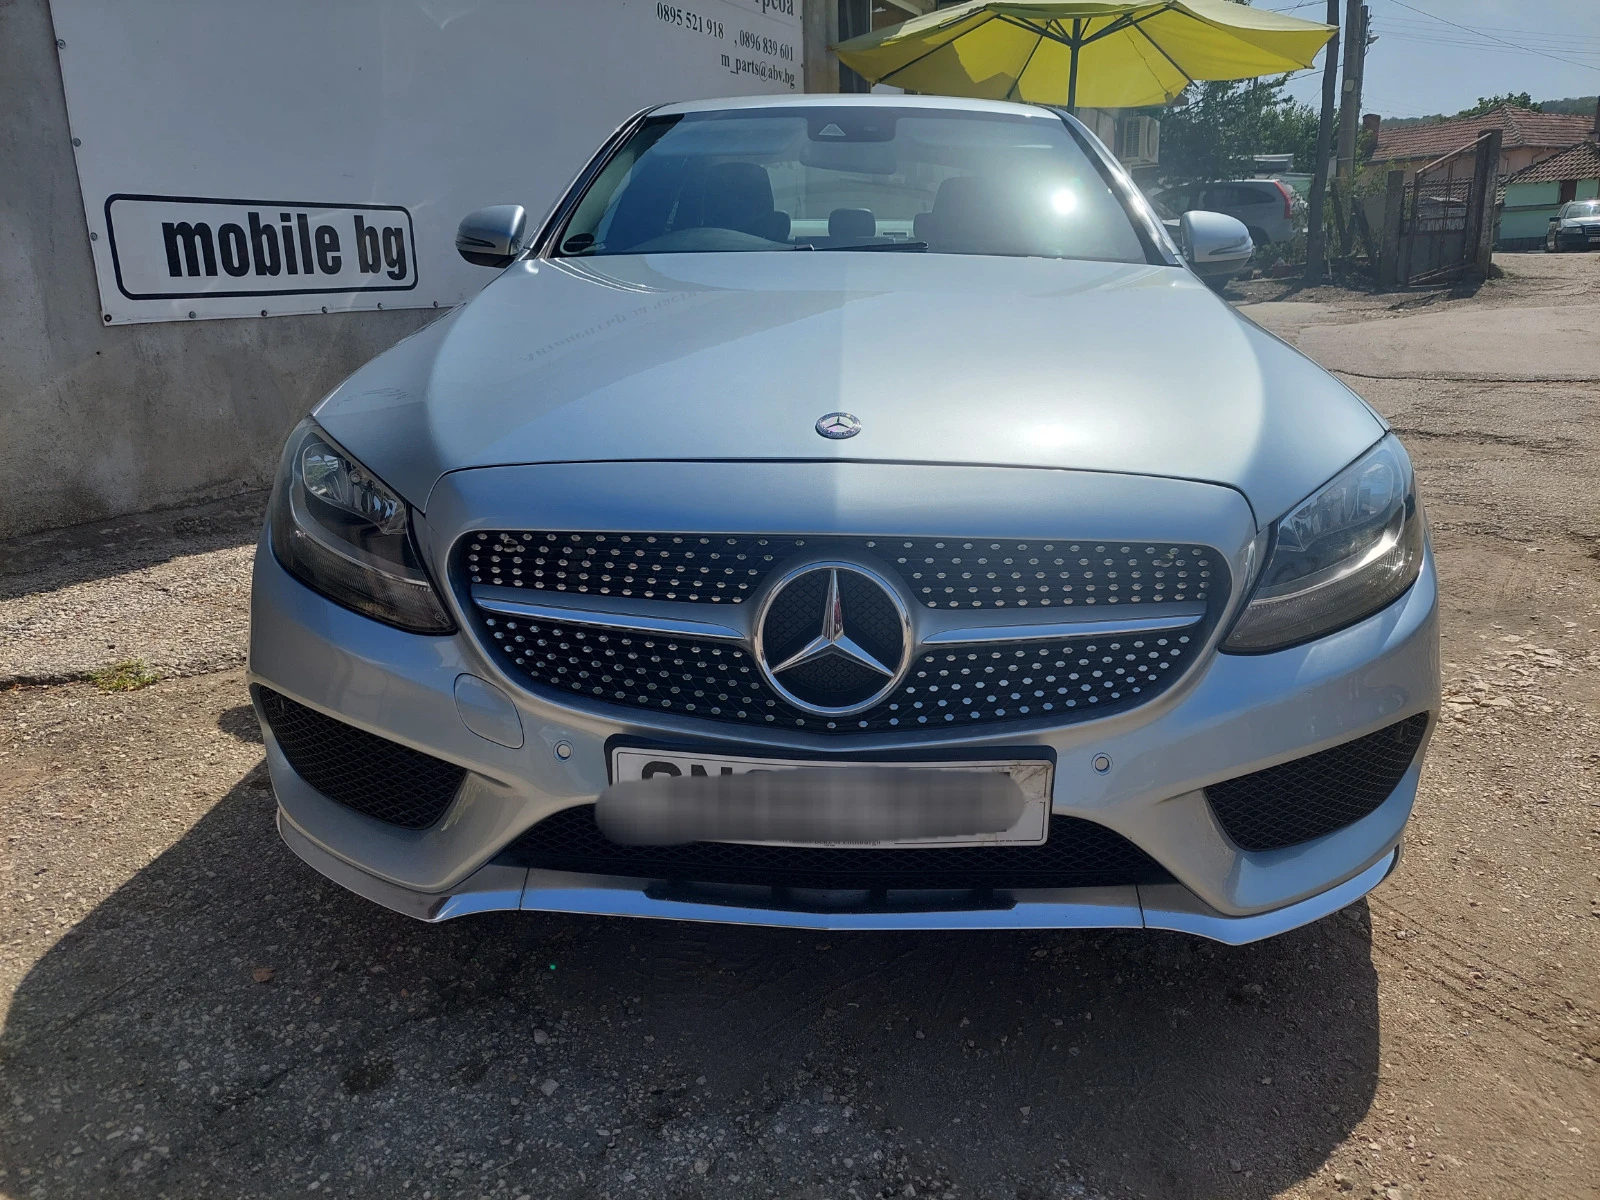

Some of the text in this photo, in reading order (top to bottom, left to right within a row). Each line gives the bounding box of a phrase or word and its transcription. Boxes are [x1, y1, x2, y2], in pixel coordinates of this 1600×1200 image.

[657, 2, 683, 26] 0895
[686, 12, 703, 33] 521
[707, 19, 724, 39] 918
[740, 30, 760, 51] 0896
[763, 37, 778, 56] 839
[780, 44, 793, 61] 601
[721, 54, 795, 89] m_parts@abv.bg
[162, 212, 407, 280] mobile bg
